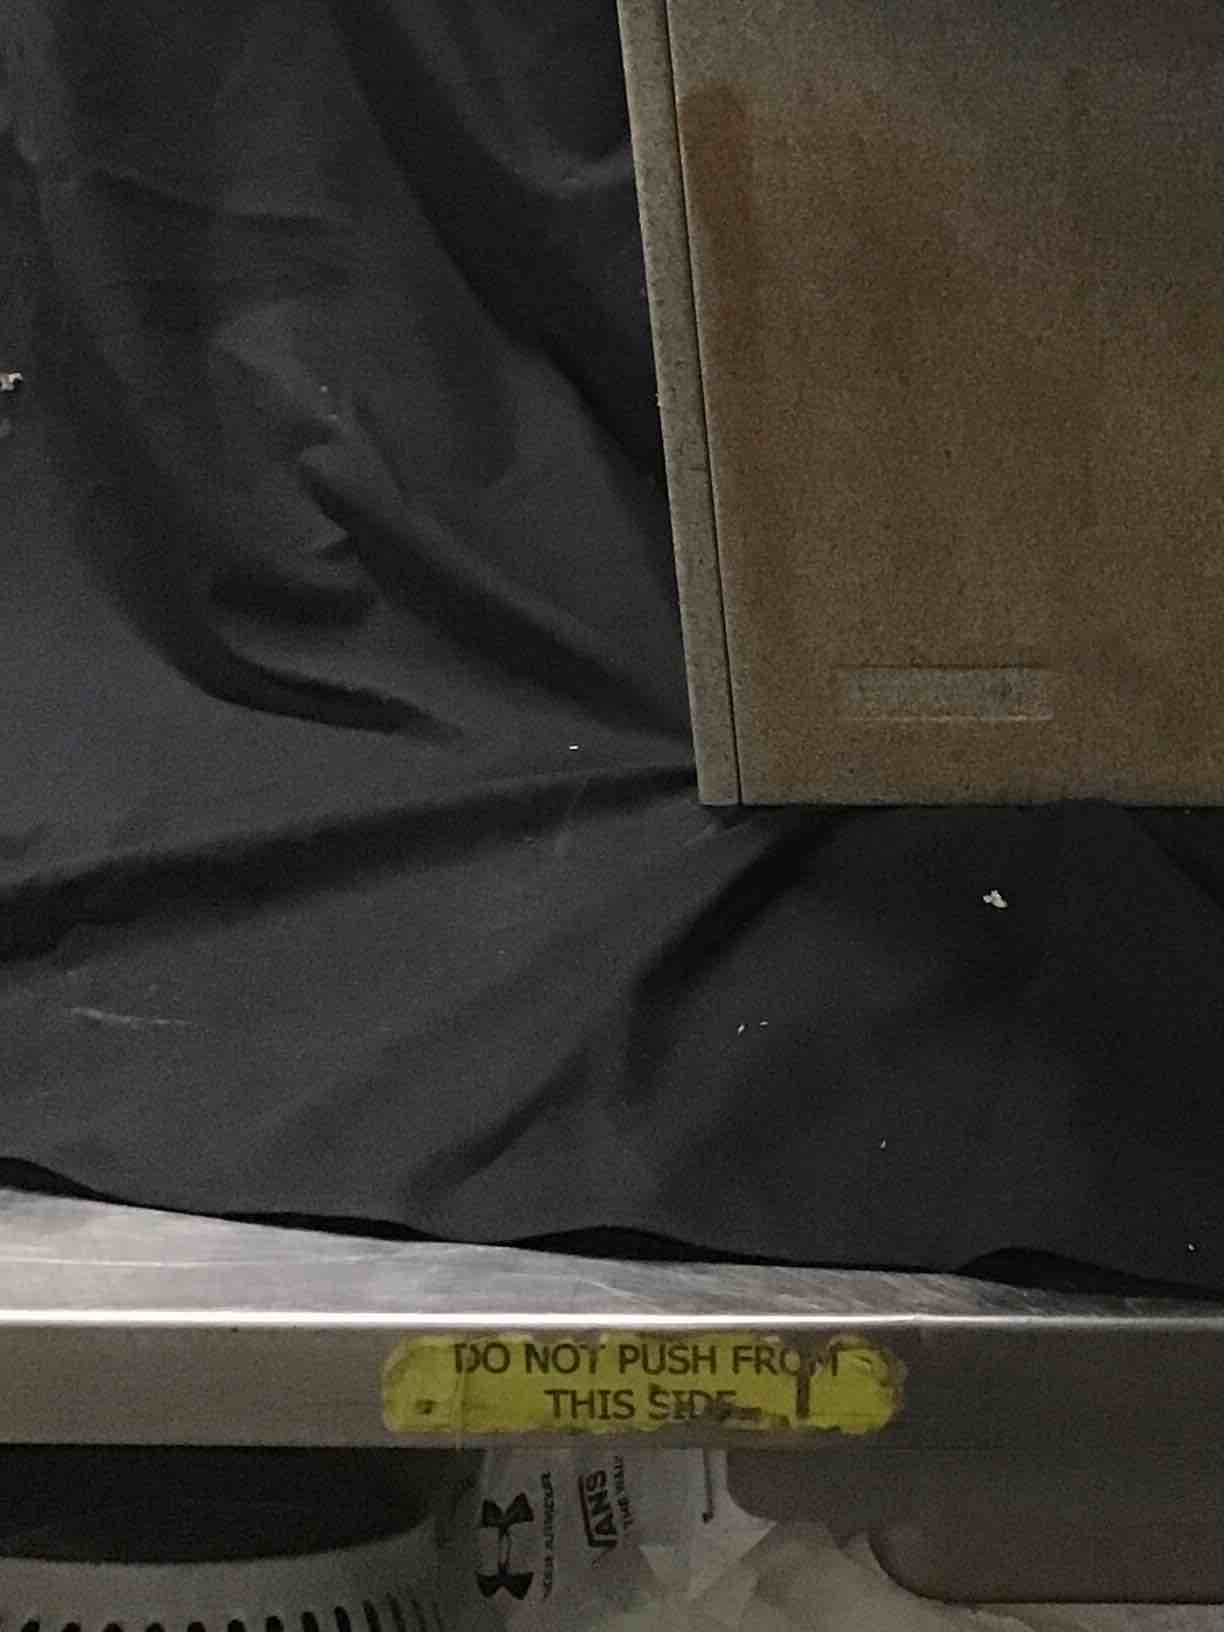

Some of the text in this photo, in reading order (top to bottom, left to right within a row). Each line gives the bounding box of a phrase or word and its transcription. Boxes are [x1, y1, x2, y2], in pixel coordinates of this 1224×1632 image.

[453, 1342, 511, 1374] DO
[524, 1343, 606, 1374] NOT
[618, 1343, 717, 1375] PUSH
[543, 1389, 635, 1419] THIS
